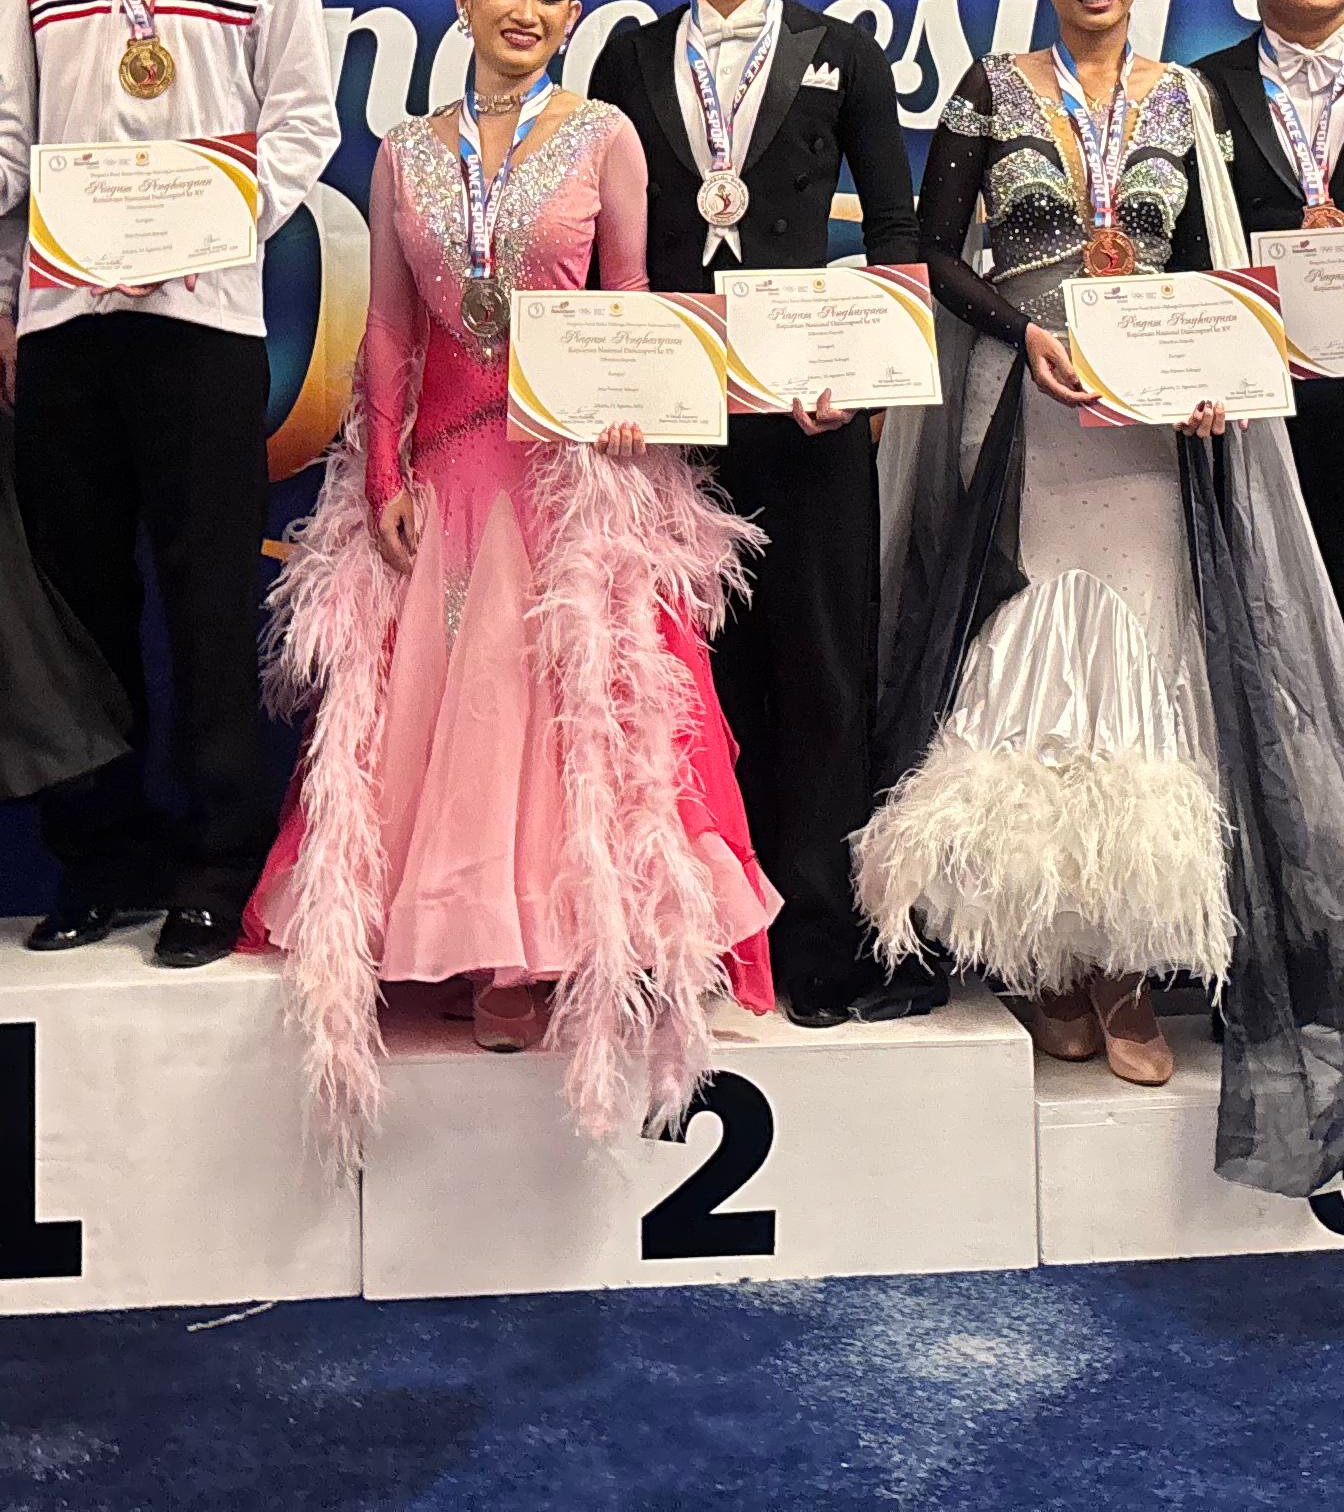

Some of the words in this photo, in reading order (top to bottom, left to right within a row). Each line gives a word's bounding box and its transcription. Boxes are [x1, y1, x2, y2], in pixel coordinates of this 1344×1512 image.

[693, 59, 715, 109] DANCE
[705, 109, 731, 163] SPORT
[1074, 108, 1095, 156] DANCE
[1275, 92, 1304, 141] DANCE
[1294, 141, 1318, 194] SPORT
[467, 154, 483, 201] DANCE
[470, 201, 485, 252] SPORT
[641, 1069, 776, 1260] 2
